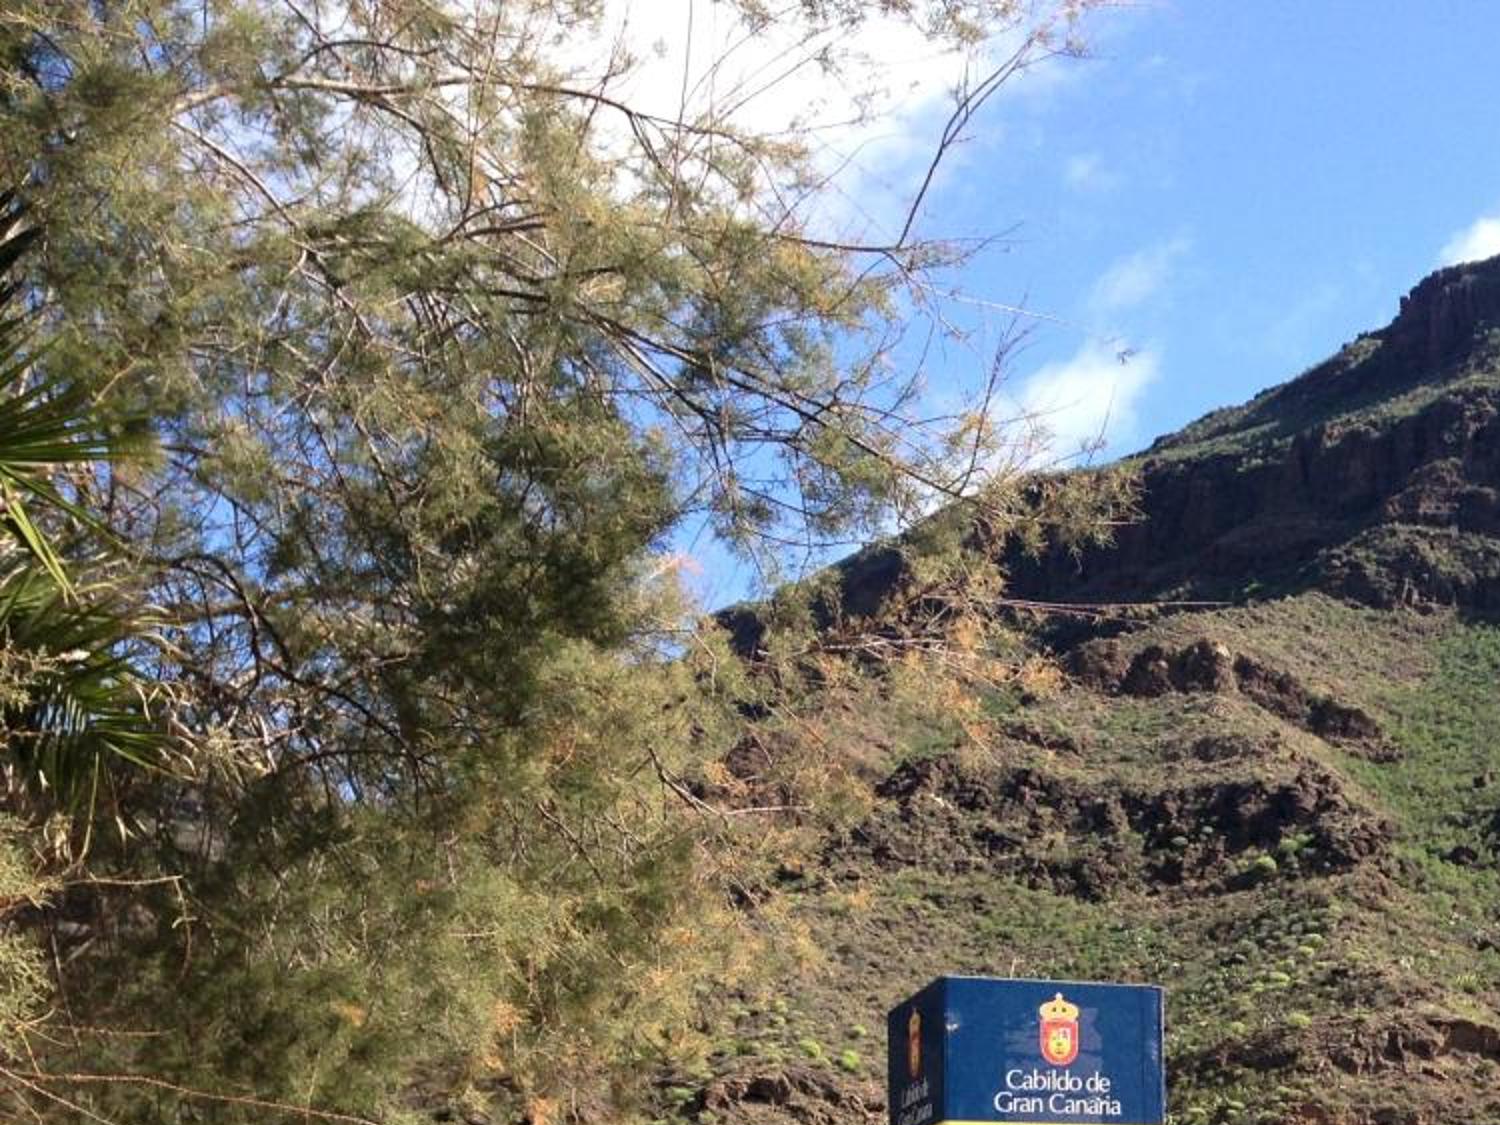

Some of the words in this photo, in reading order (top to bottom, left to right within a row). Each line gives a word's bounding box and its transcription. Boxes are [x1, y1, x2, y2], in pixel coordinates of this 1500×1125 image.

[1006, 1068, 1082, 1091] Cabildo
[1086, 1071, 1111, 1092] de
[993, 1091, 1043, 1113] Gran
[1049, 1093, 1122, 1115] Canaria
